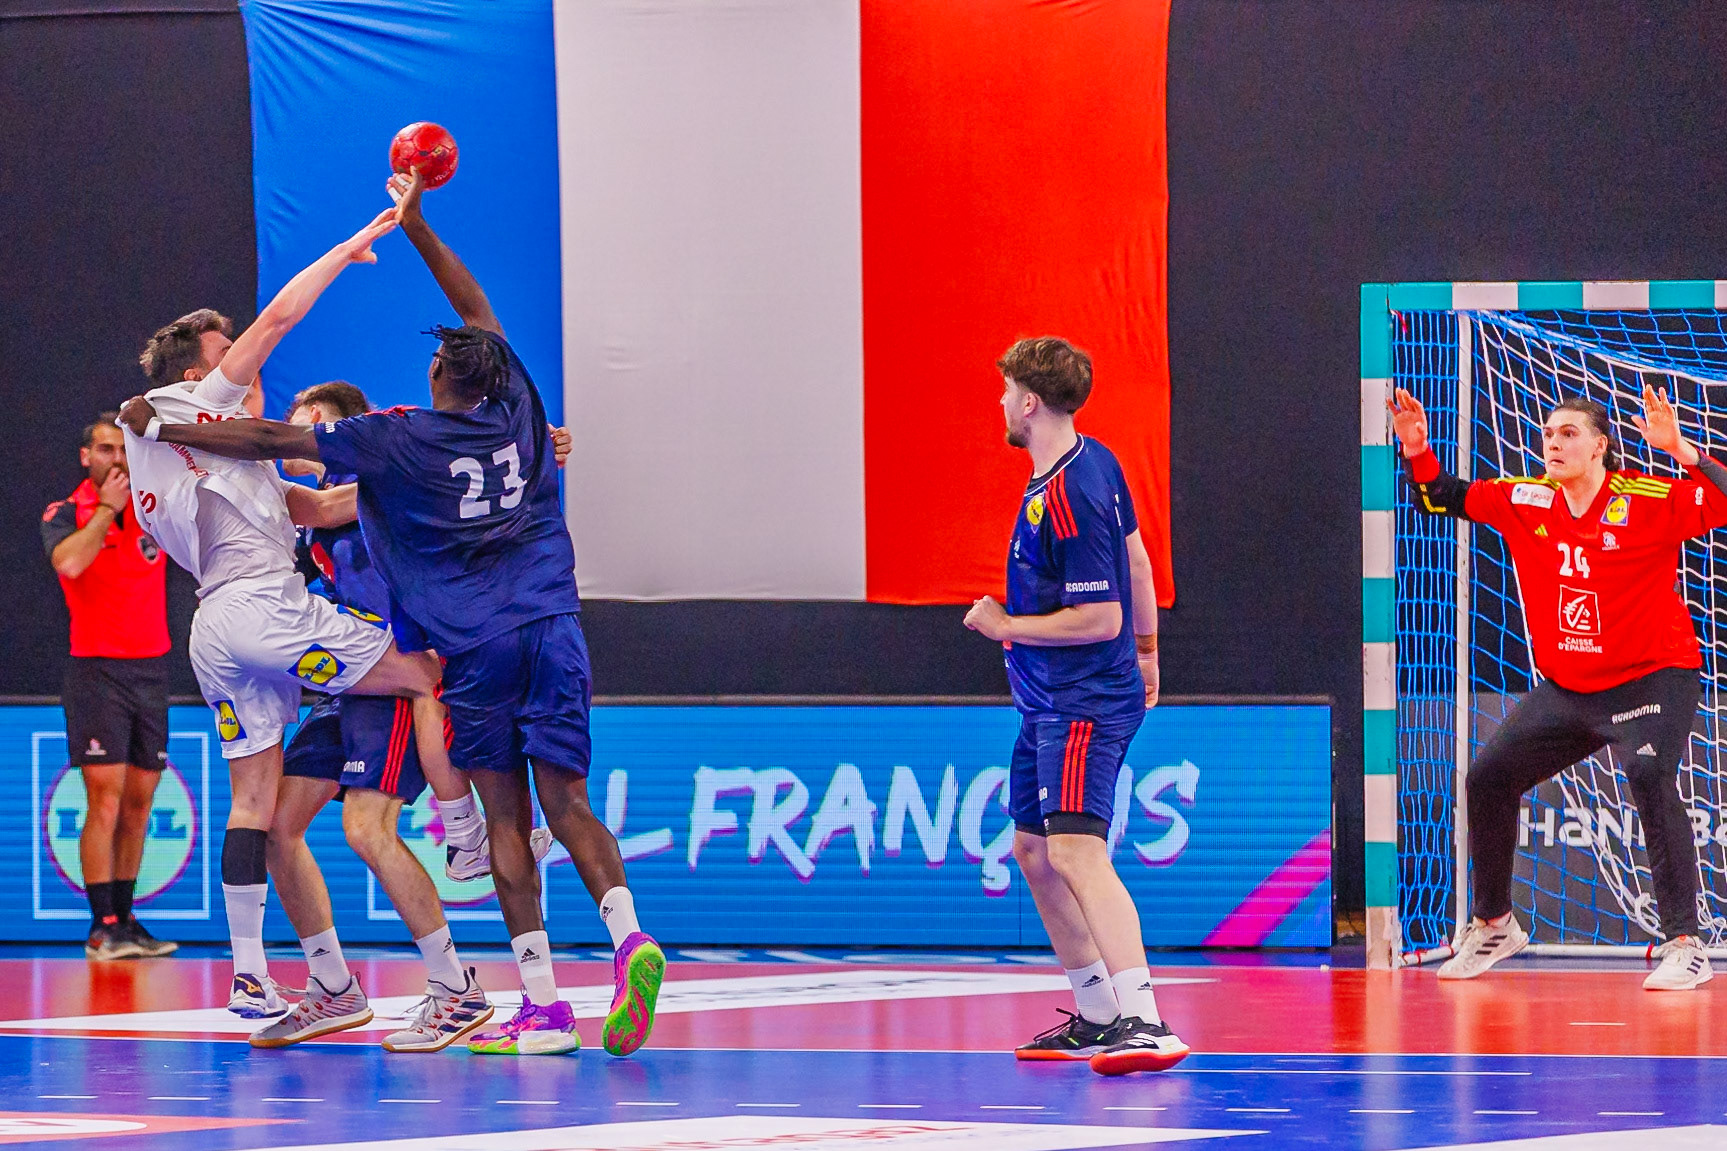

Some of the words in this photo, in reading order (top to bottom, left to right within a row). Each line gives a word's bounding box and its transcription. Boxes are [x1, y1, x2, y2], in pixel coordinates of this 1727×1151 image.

[449, 442, 527, 518] 23
[1557, 542, 1590, 578] 24
[1565, 636, 1594, 646] CAISSE
[686, 758, 1201, 898] FRANÇIS
